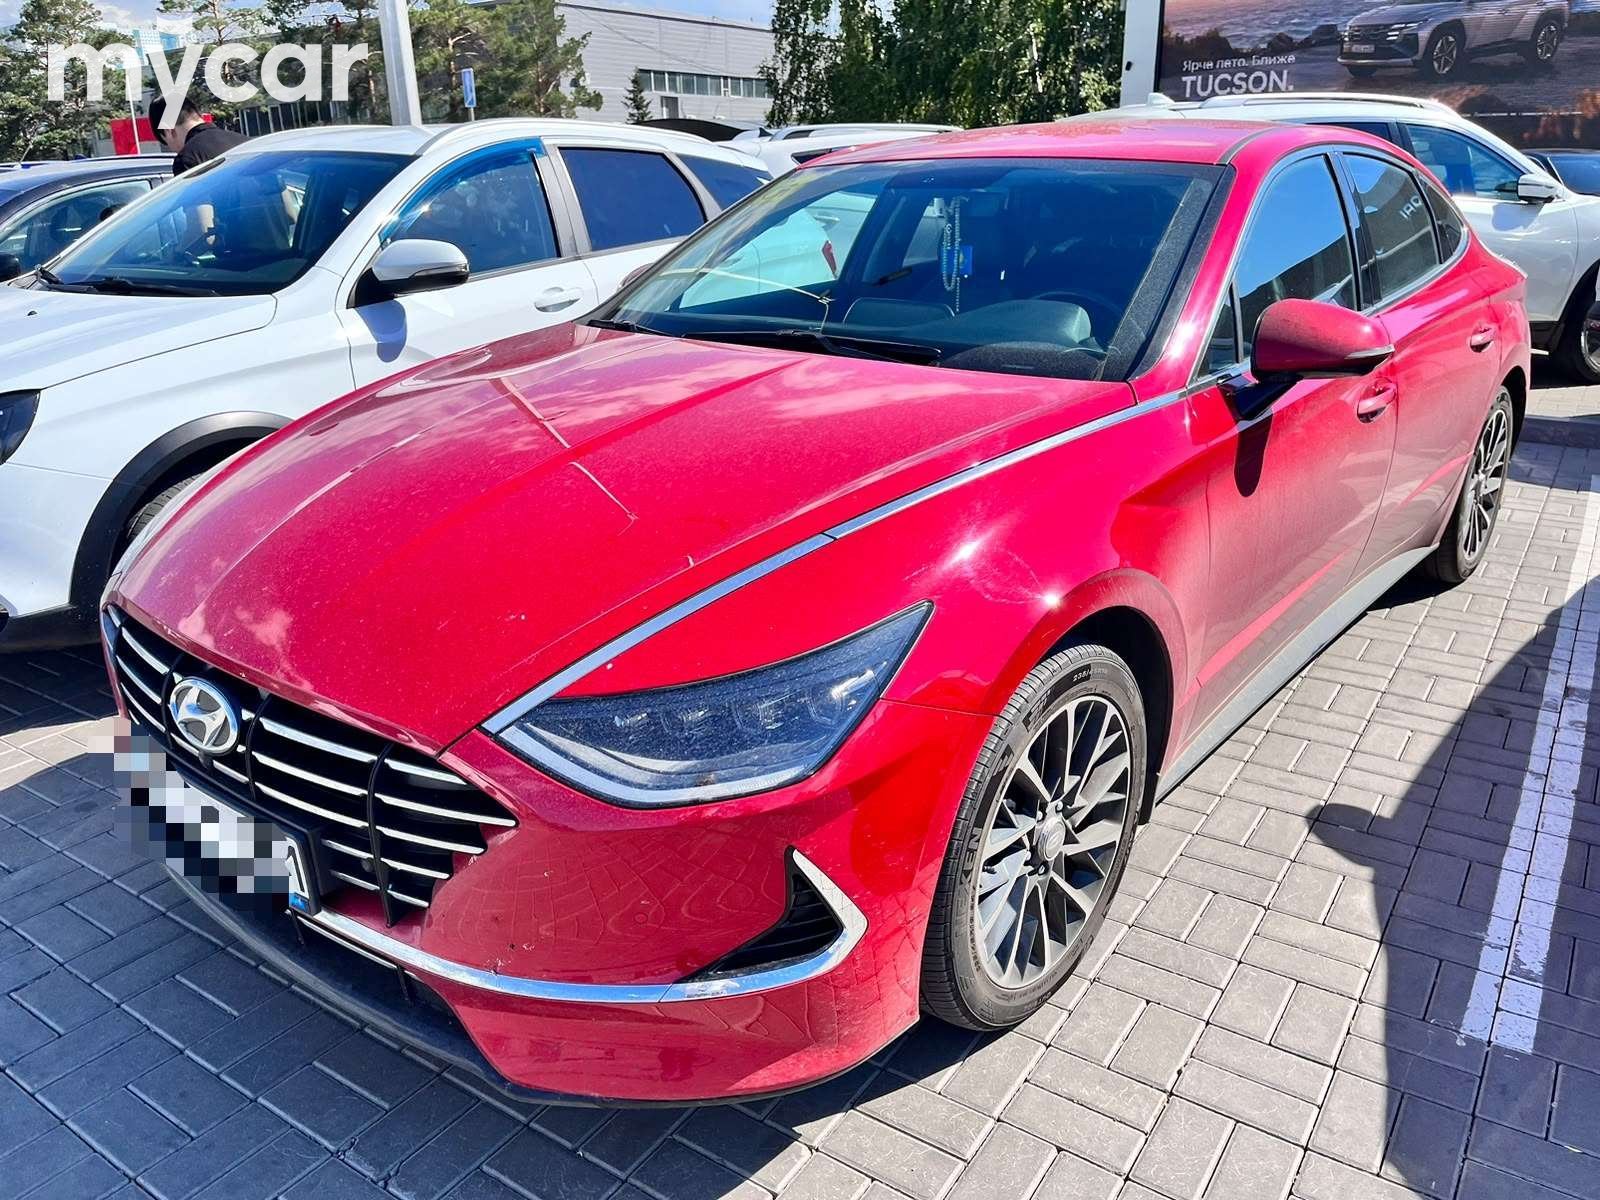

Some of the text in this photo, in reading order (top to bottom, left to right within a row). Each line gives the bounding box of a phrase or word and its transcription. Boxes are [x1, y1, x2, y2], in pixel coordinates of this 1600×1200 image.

[1182, 60, 1214, 73] Ярче
[1252, 54, 1296, 66] Ближе
[1181, 69, 1295, 98] TUCSON.
